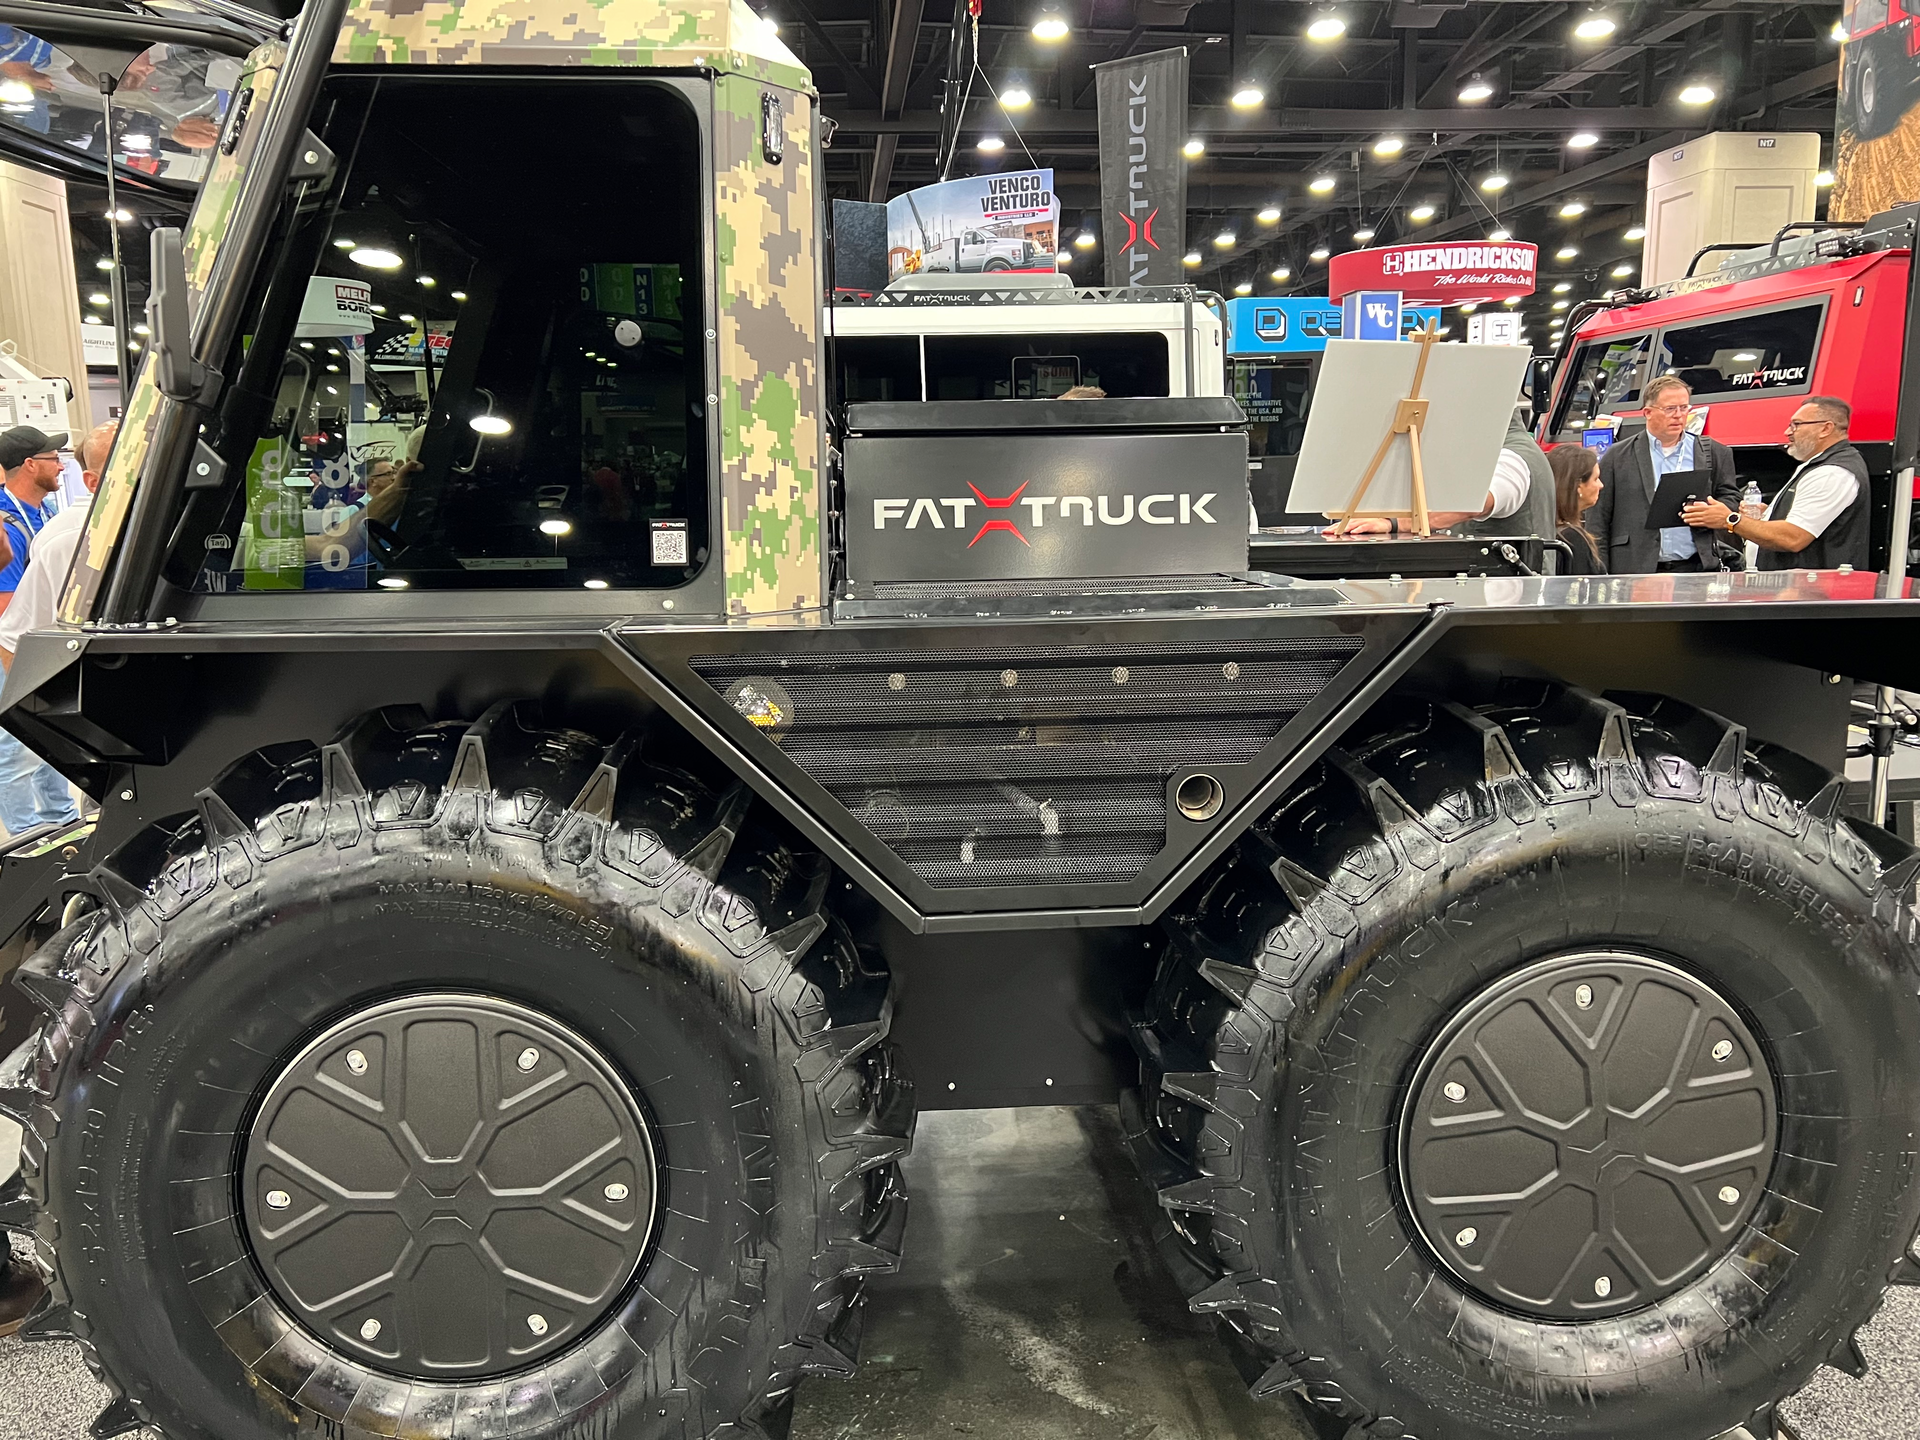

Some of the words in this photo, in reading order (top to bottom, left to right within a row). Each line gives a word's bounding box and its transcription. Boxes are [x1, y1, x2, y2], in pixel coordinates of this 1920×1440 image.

[1129, 75, 1149, 216] TRUCK
[1759, 139, 1775, 148] N17
[988, 175, 1041, 195] VENCO
[981, 191, 1051, 212] VENTURO
[1404, 246, 1535, 272] HENDRICKSON
[1434, 275, 1457, 287] The
[1457, 273, 1493, 284] World
[1493, 273, 1517, 285] Rides
[938, 294, 971, 302] TRUCK
[1366, 303, 1393, 328] WC
[1732, 372, 1755, 386] FAT
[1763, 366, 1805, 382] TRUCK
[873, 498, 977, 530] FAT
[1020, 493, 1218, 527] TRUCK
[379, 882, 419, 896] MAX
[422, 882, 468, 895] LOAD
